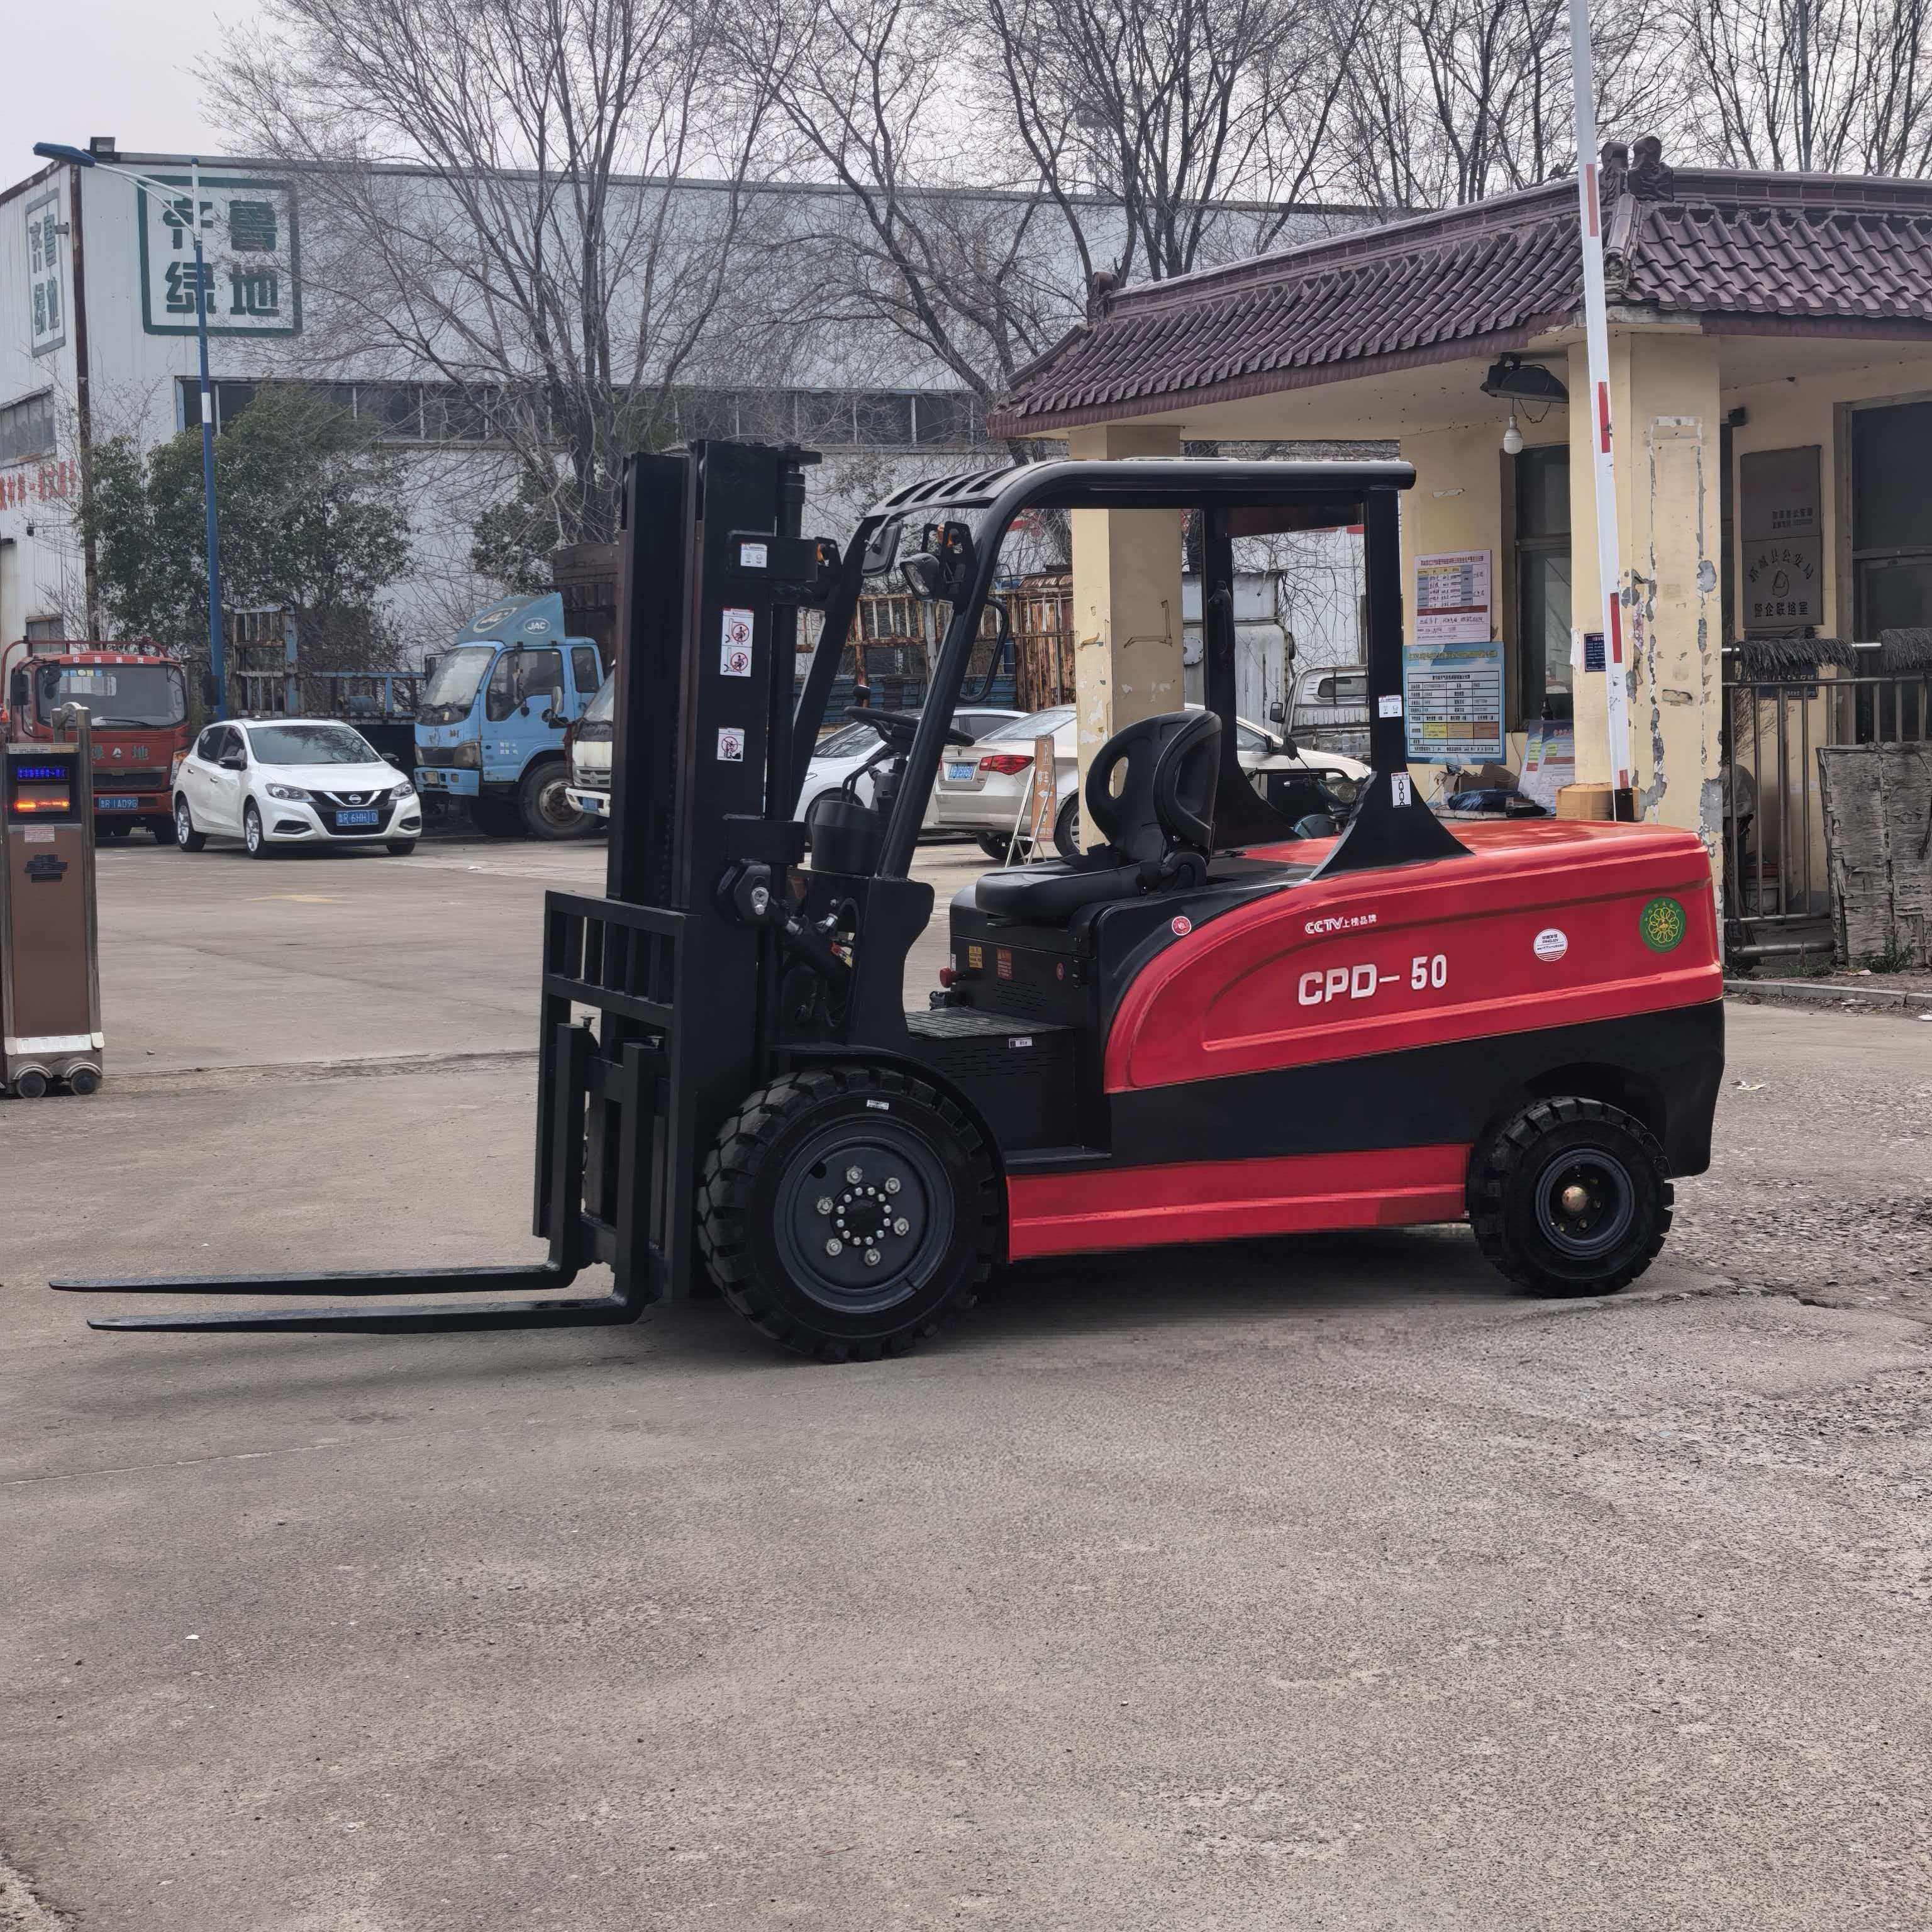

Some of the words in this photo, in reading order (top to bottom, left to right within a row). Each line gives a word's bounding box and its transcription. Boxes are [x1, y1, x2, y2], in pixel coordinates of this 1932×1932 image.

[165, 261, 280, 316] 绿地
[528, 622, 546, 630] JAC
[1305, 916, 1343, 934] CCTV
[1342, 914, 1377, 928] 上榜品牌
[1411, 954, 1446, 990] 50
